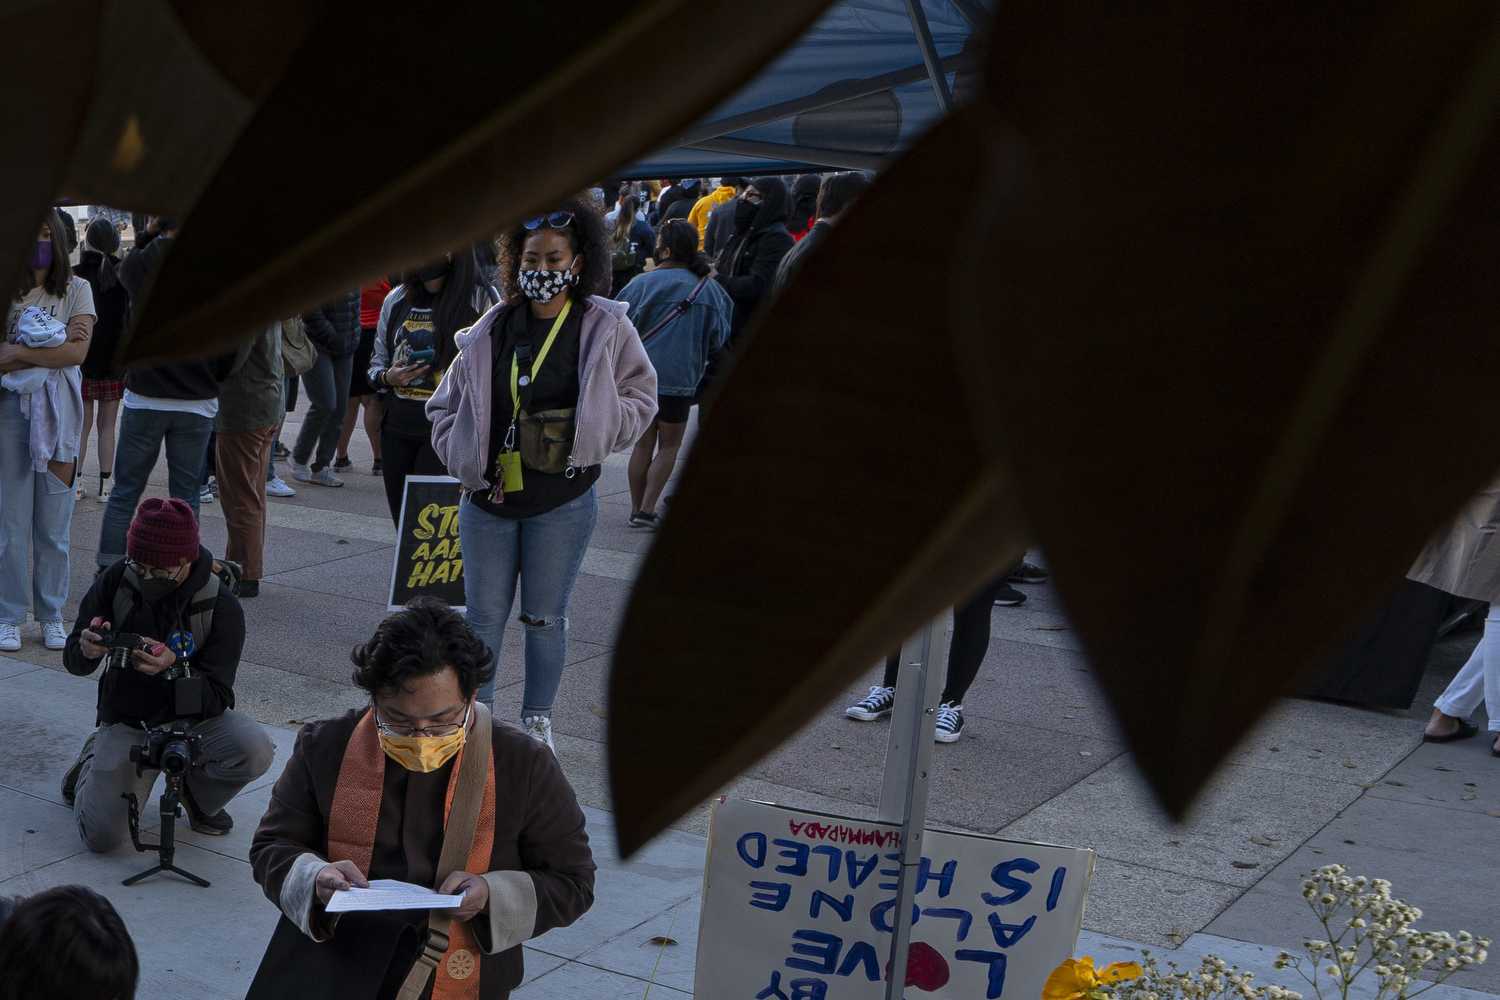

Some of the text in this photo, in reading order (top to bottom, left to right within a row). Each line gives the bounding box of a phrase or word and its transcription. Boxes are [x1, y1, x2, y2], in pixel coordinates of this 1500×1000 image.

[789, 818, 904, 849] HAMMAPADA
[736, 831, 1067, 912] IS HEALED
[749, 880, 1038, 949] ALONE
